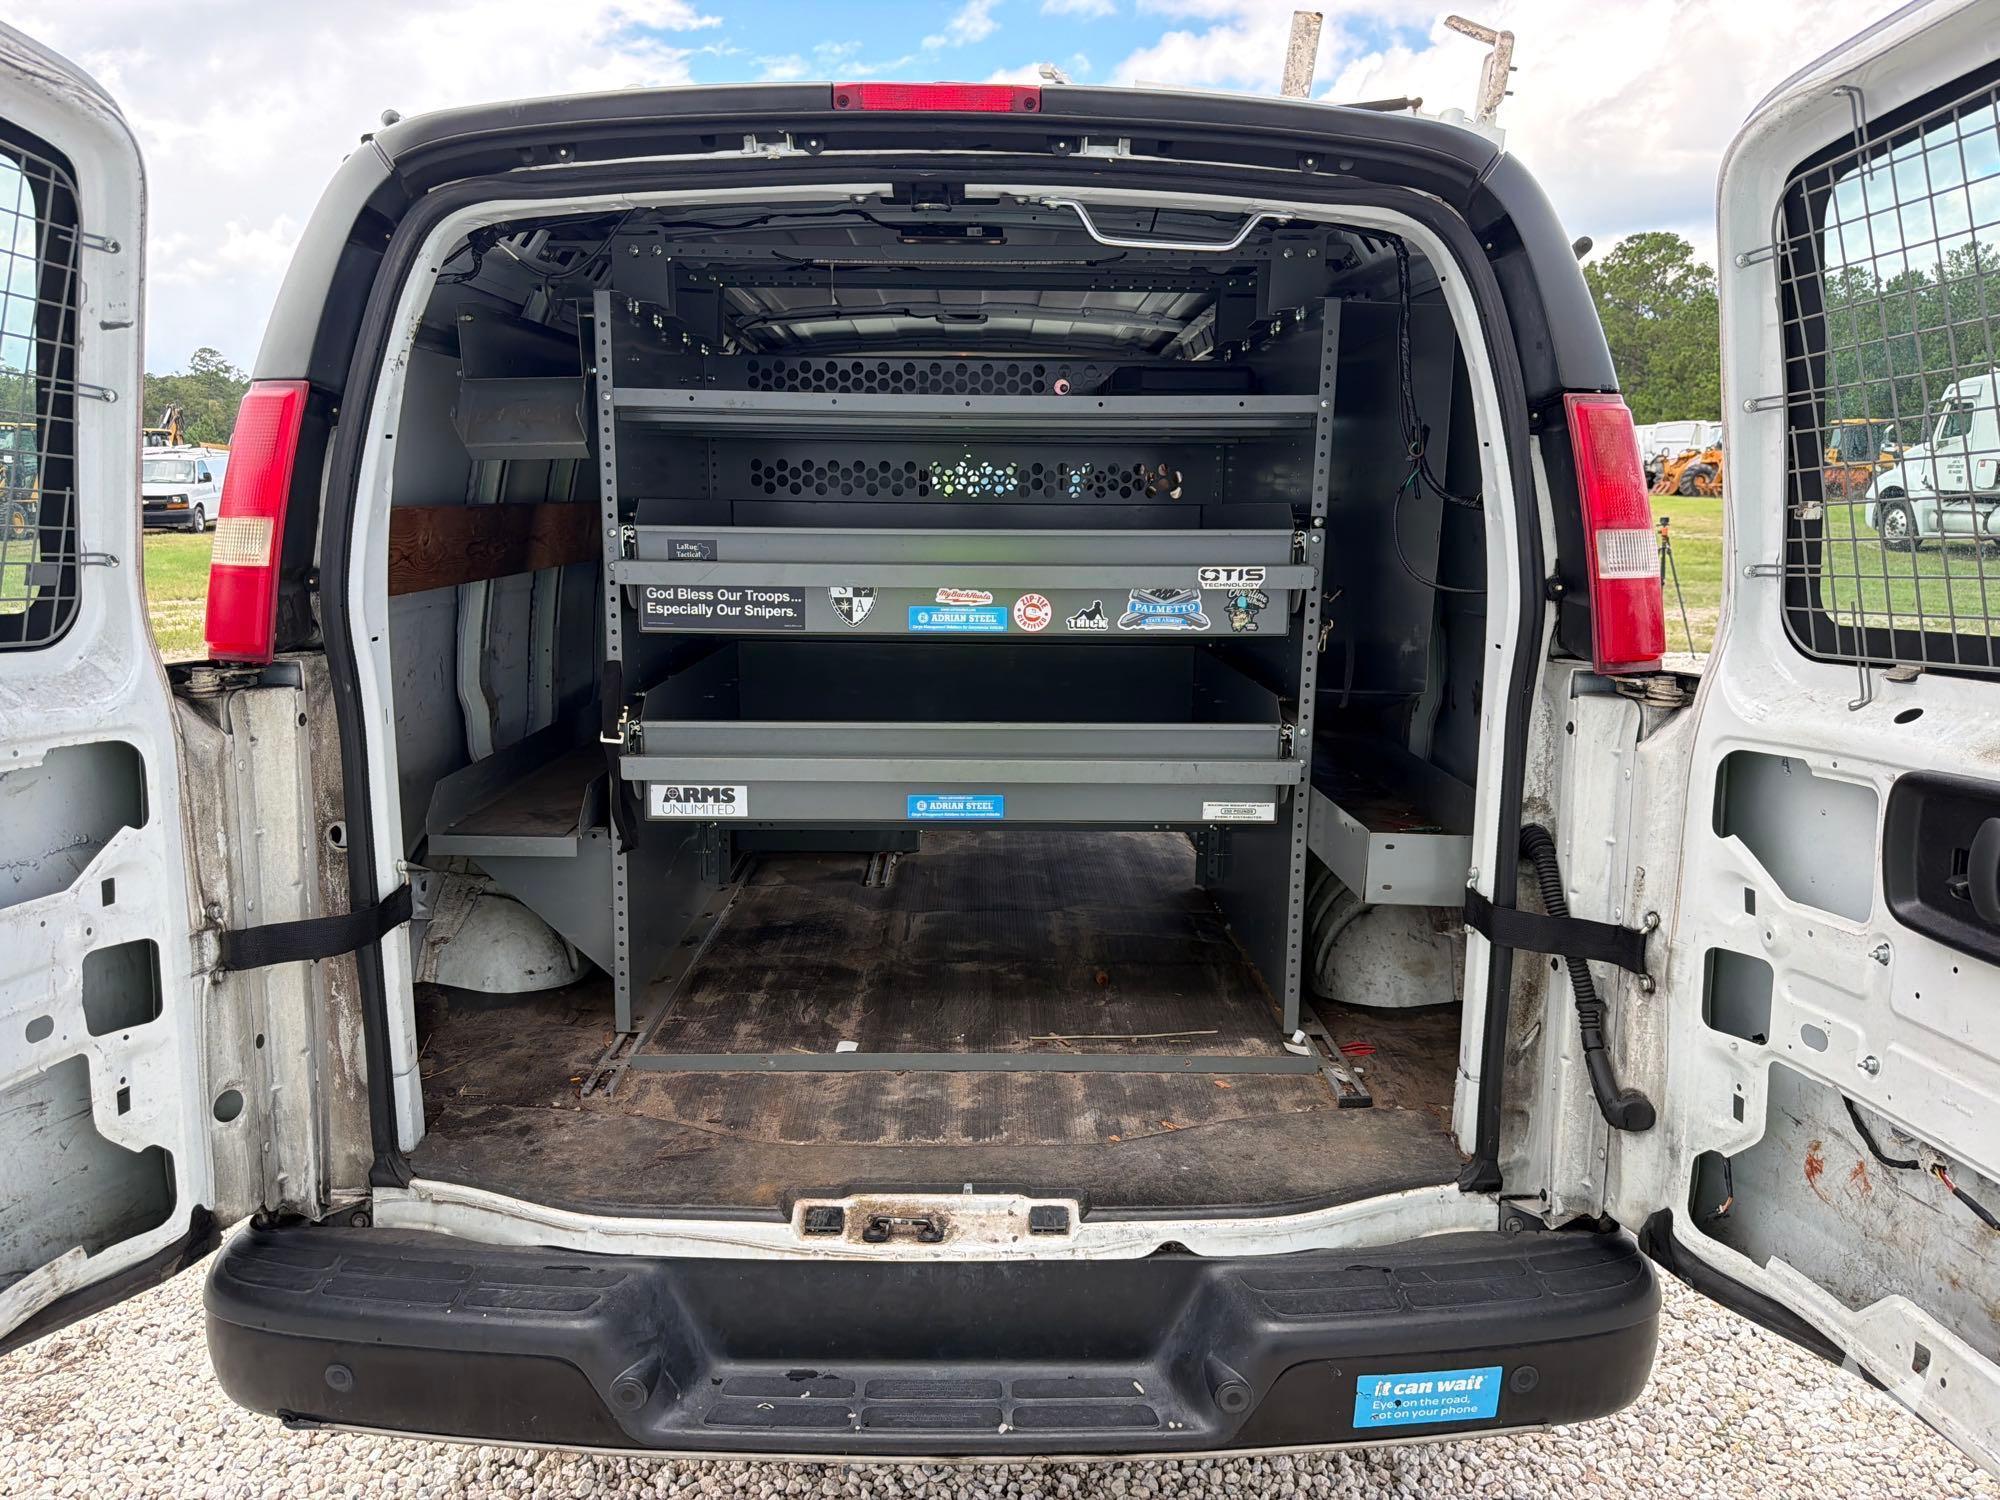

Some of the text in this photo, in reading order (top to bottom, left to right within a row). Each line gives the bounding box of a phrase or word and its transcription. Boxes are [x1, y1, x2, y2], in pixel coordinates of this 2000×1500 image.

[676, 543, 699, 551] LaRue
[1200, 568, 1264, 581] OTIS
[646, 587, 802, 605] God Bless Our Troops...
[646, 603, 797, 620] Especially Our Snipers.
[1135, 603, 1196, 614] PALMETTO
[931, 614, 997, 623] ADRIAN STEEL
[1068, 618, 1107, 629] THICK
[662, 787, 736, 804] ARMS
[662, 804, 736, 815] UNLIMITED
[929, 802, 994, 810] ADRIAN STEEL
[1374, 1375, 1484, 1397] it can wait
[1403, 1400, 1417, 1408] on
[1420, 1396, 1440, 1407] the
[1441, 1394, 1471, 1406] road,
[1394, 1411, 1410, 1419] on
[1412, 1409, 1439, 1421] your
[1440, 1405, 1478, 1416] phone
